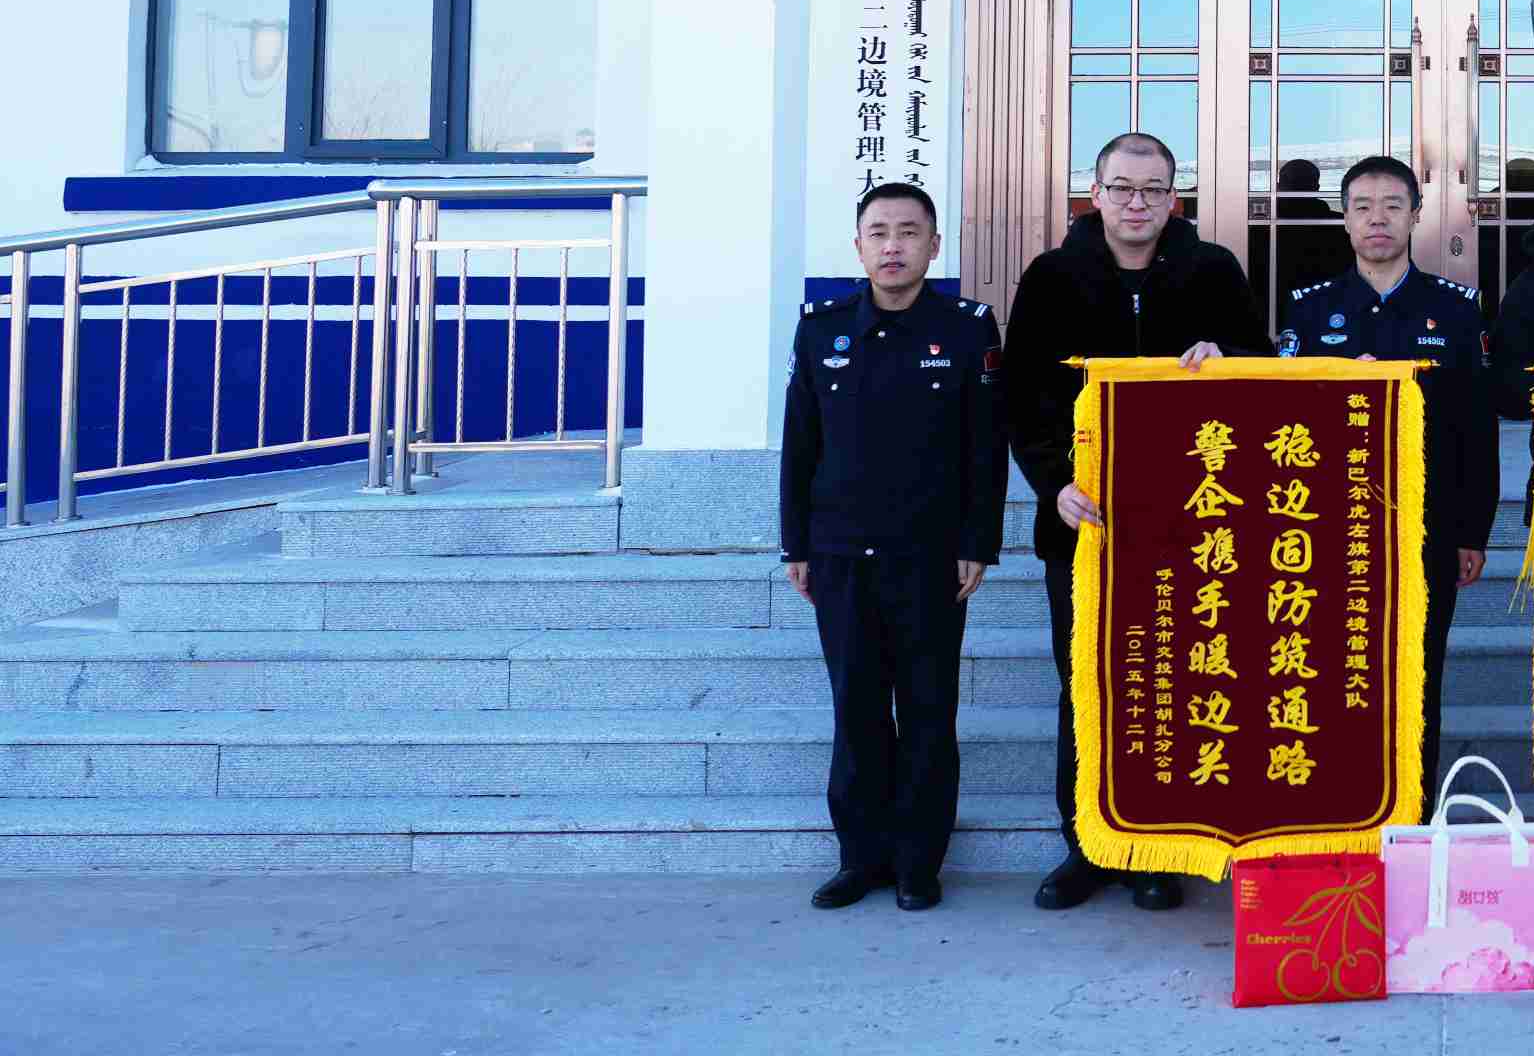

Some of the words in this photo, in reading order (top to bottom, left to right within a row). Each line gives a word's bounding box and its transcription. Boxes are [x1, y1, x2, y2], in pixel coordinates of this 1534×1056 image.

[1184, 419, 1244, 786] 警企携手暖边关
[1263, 423, 1321, 786] 稳边固防筑通路
